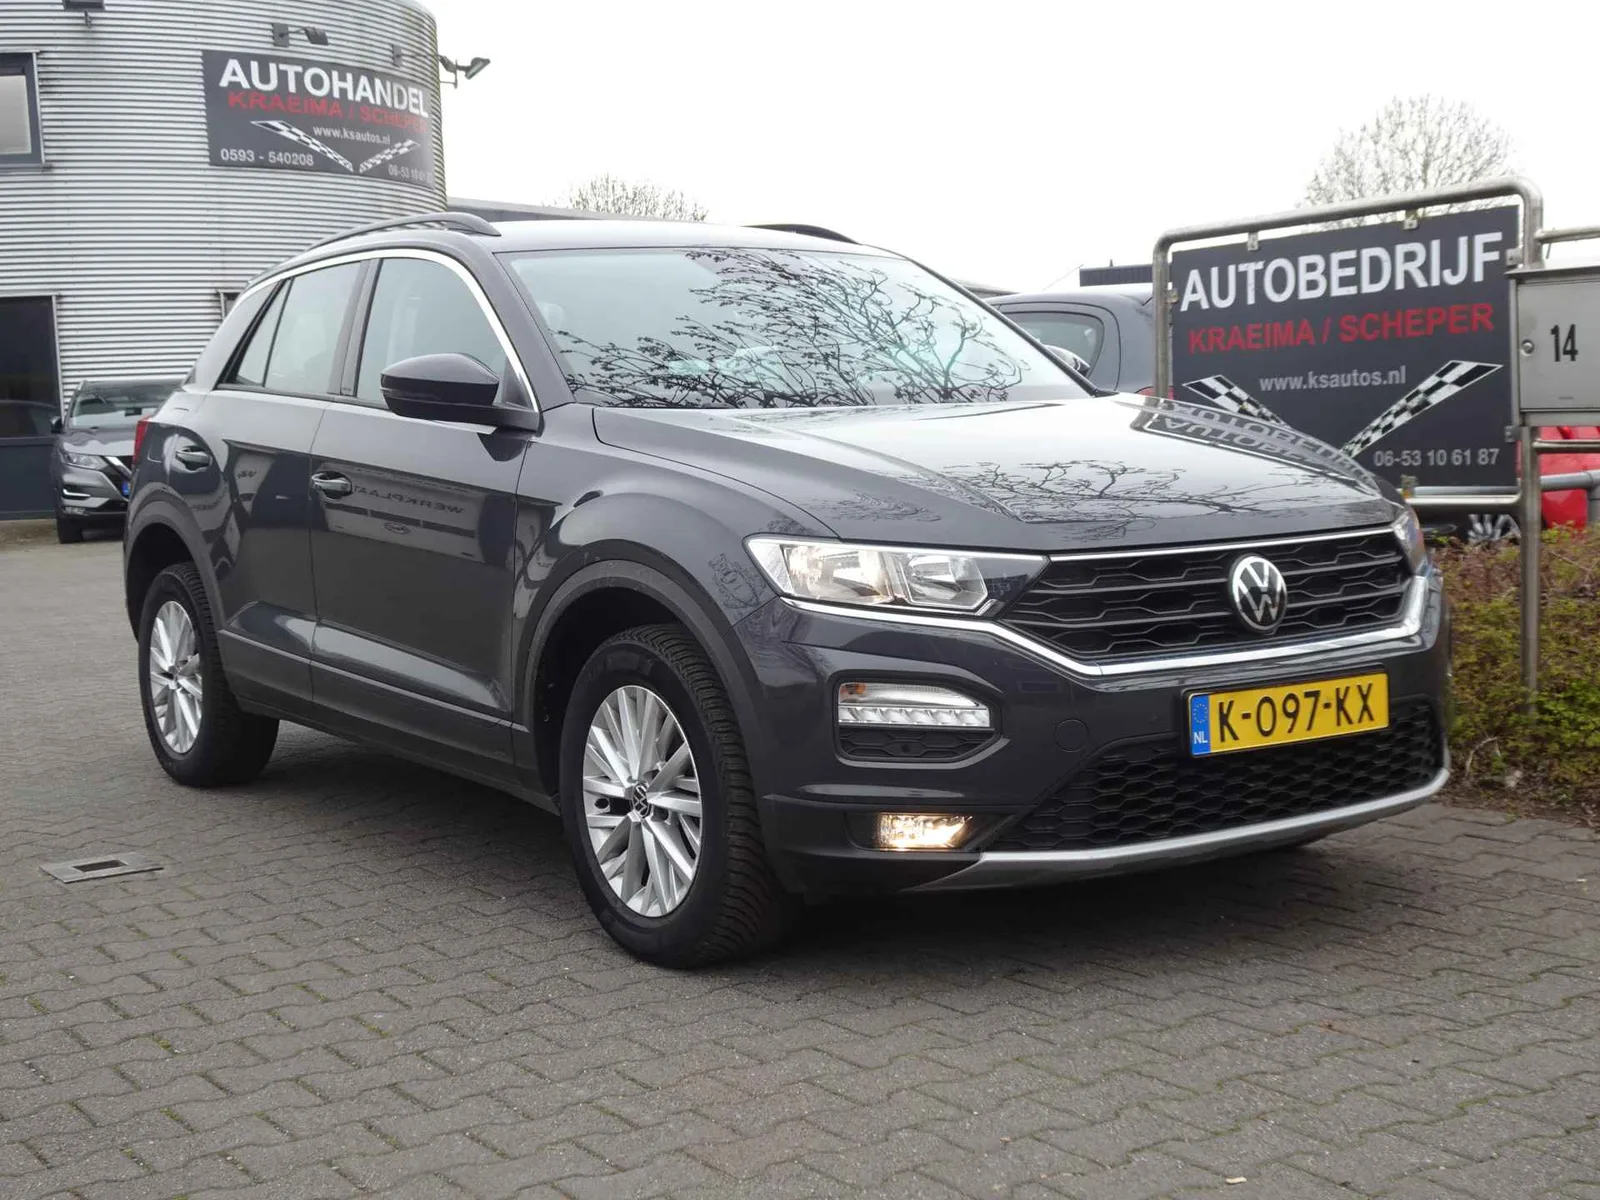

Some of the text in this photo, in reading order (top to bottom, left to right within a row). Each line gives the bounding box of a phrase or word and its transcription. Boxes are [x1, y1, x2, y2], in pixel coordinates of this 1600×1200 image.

[219, 58, 429, 118] AUTOHANDEL
[227, 91, 343, 119] KRAEIMA
[313, 125, 391, 145] www.ksautos.nl
[220, 148, 255, 162] 0593
[268, 151, 314, 166] 540208
[1180, 232, 1503, 312] AUTOBEDRIJF
[1188, 303, 1494, 354] KRAEIMA / SCHEPER
[1551, 323, 1579, 363] 14
[1259, 365, 1406, 392] www.ksautos.nl
[1373, 448, 1500, 467] 06-53 10 61 87
[1217, 683, 1374, 743] K-097-KX
[1193, 731, 1208, 744] NL
